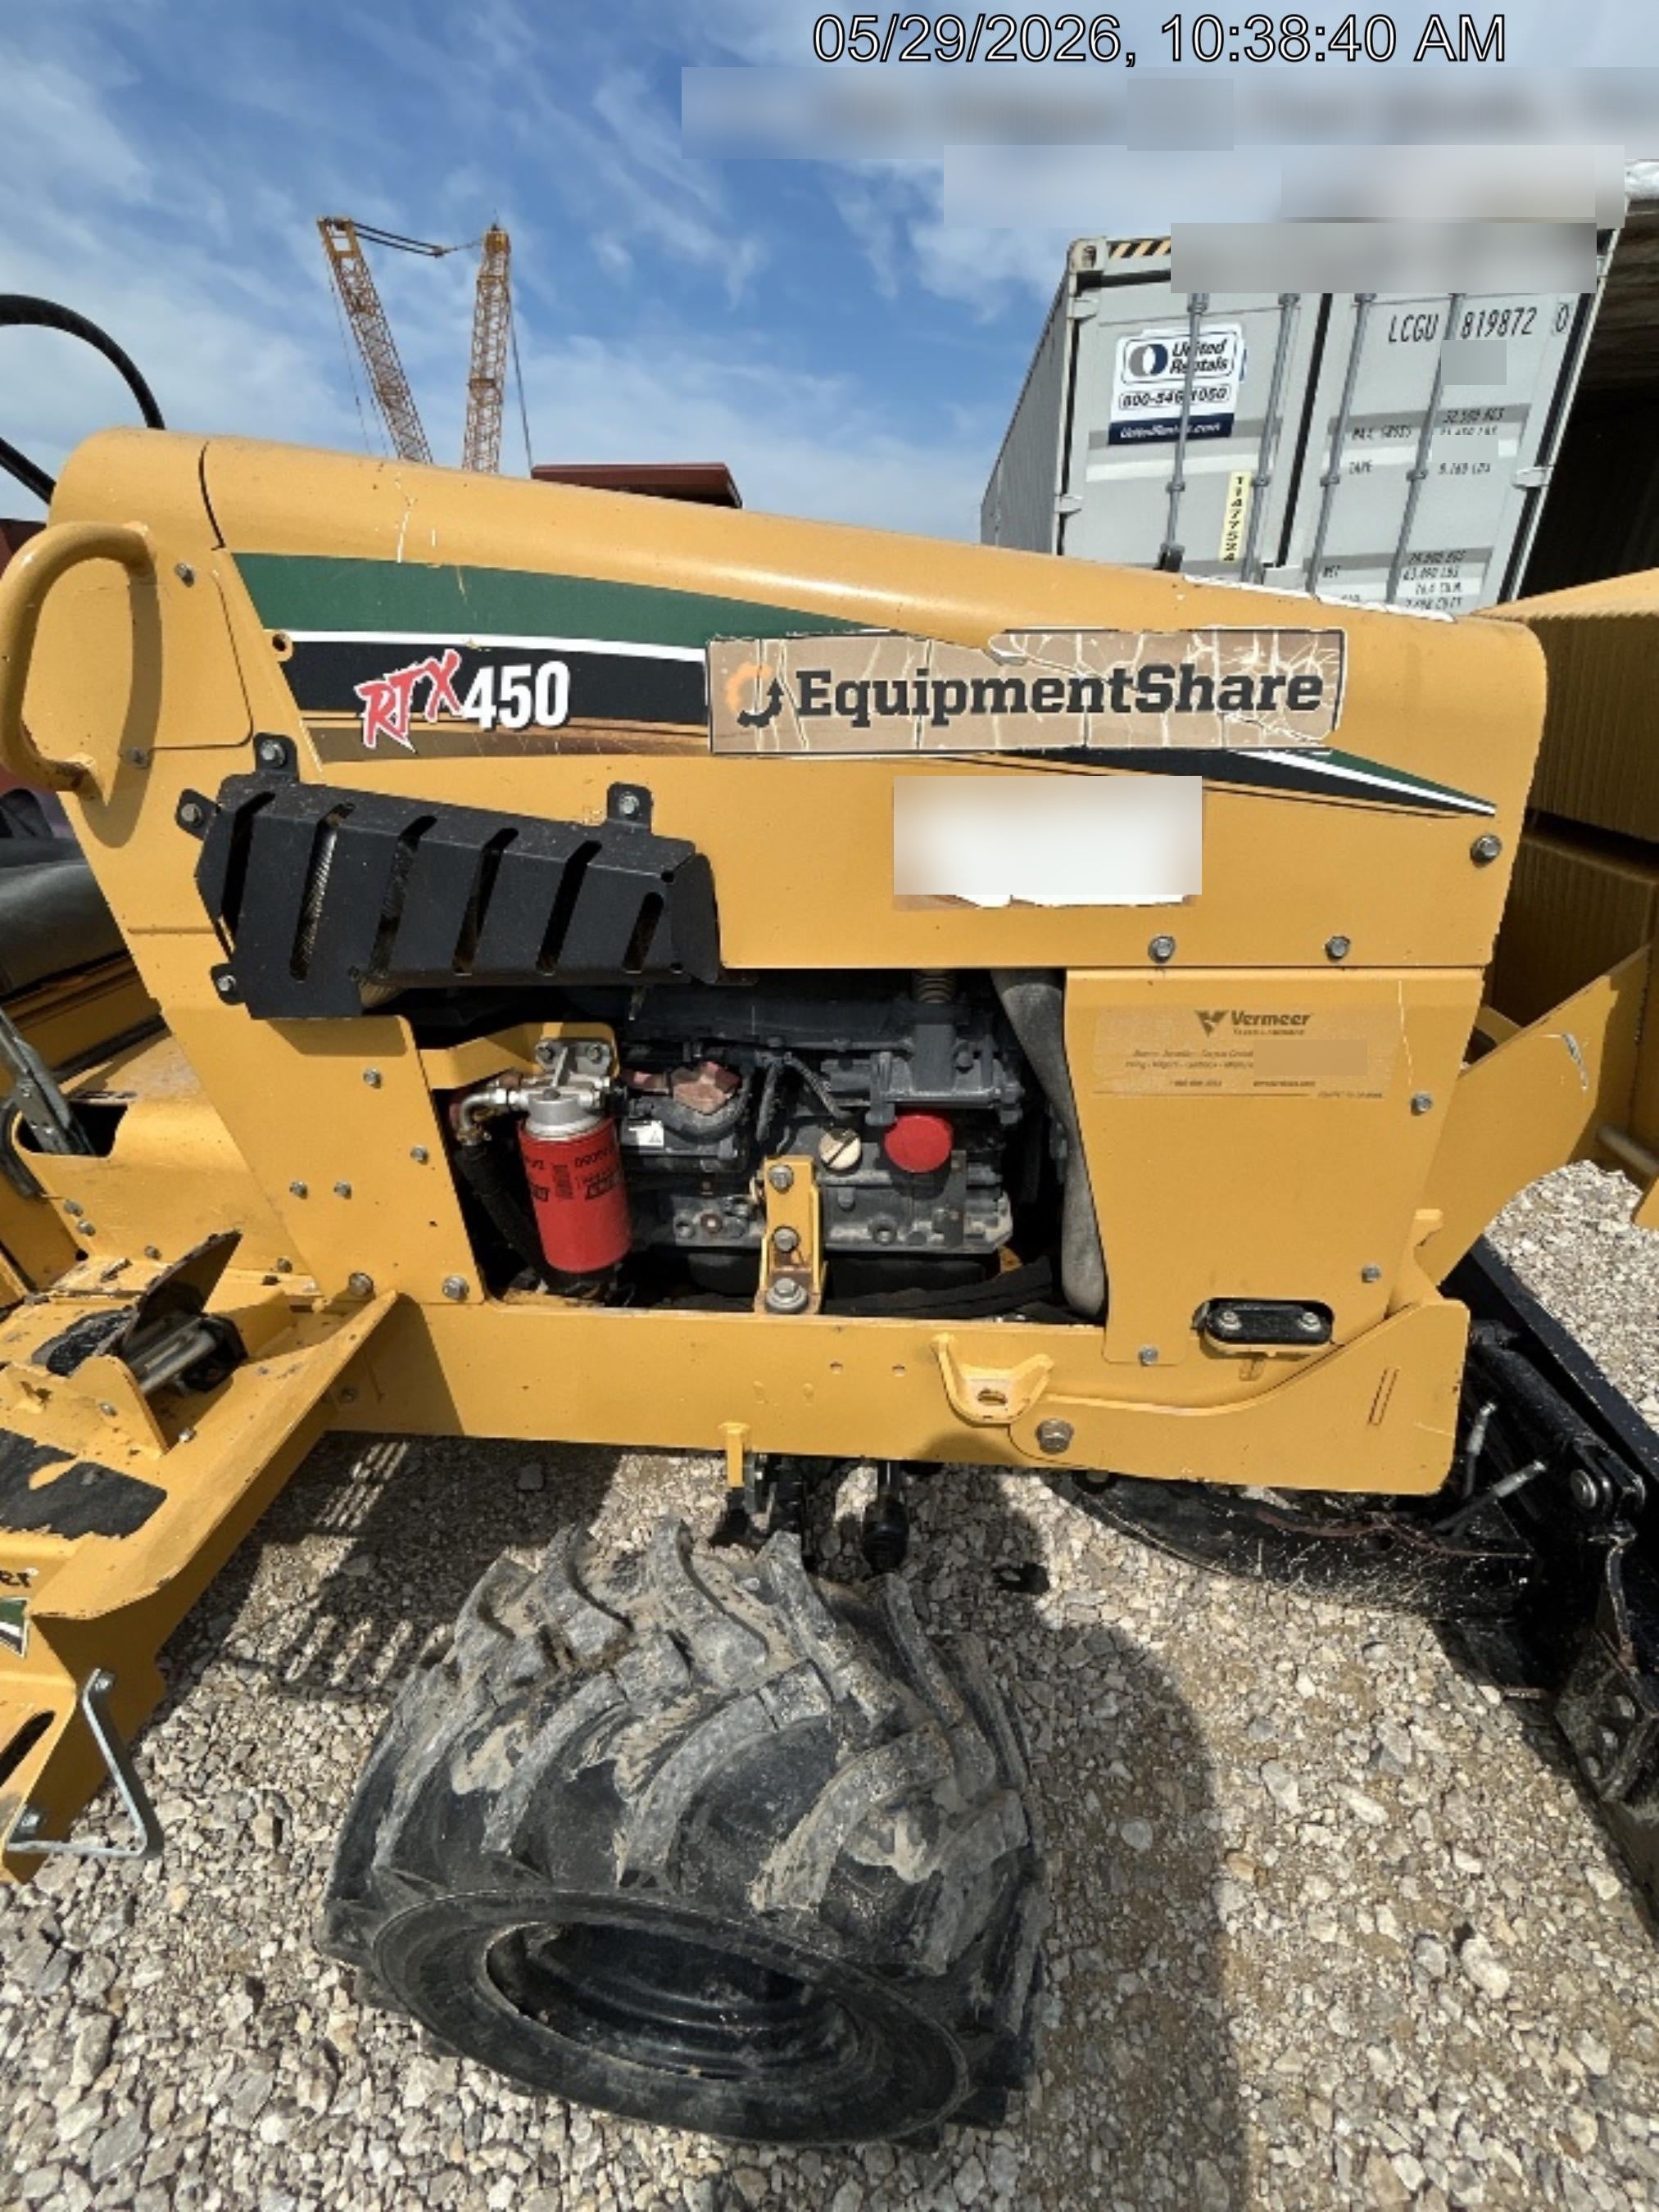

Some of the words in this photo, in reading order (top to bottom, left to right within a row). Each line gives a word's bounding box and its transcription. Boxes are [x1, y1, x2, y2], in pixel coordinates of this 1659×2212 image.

[1389, 313, 1439, 342] LCGU
[1462, 306, 1537, 339] 819872
[354, 649, 464, 754] RTX
[461, 660, 572, 731] 450
[796, 664, 1325, 728] EquipmentShare
[1231, 1009, 1312, 1026] Vermeer
